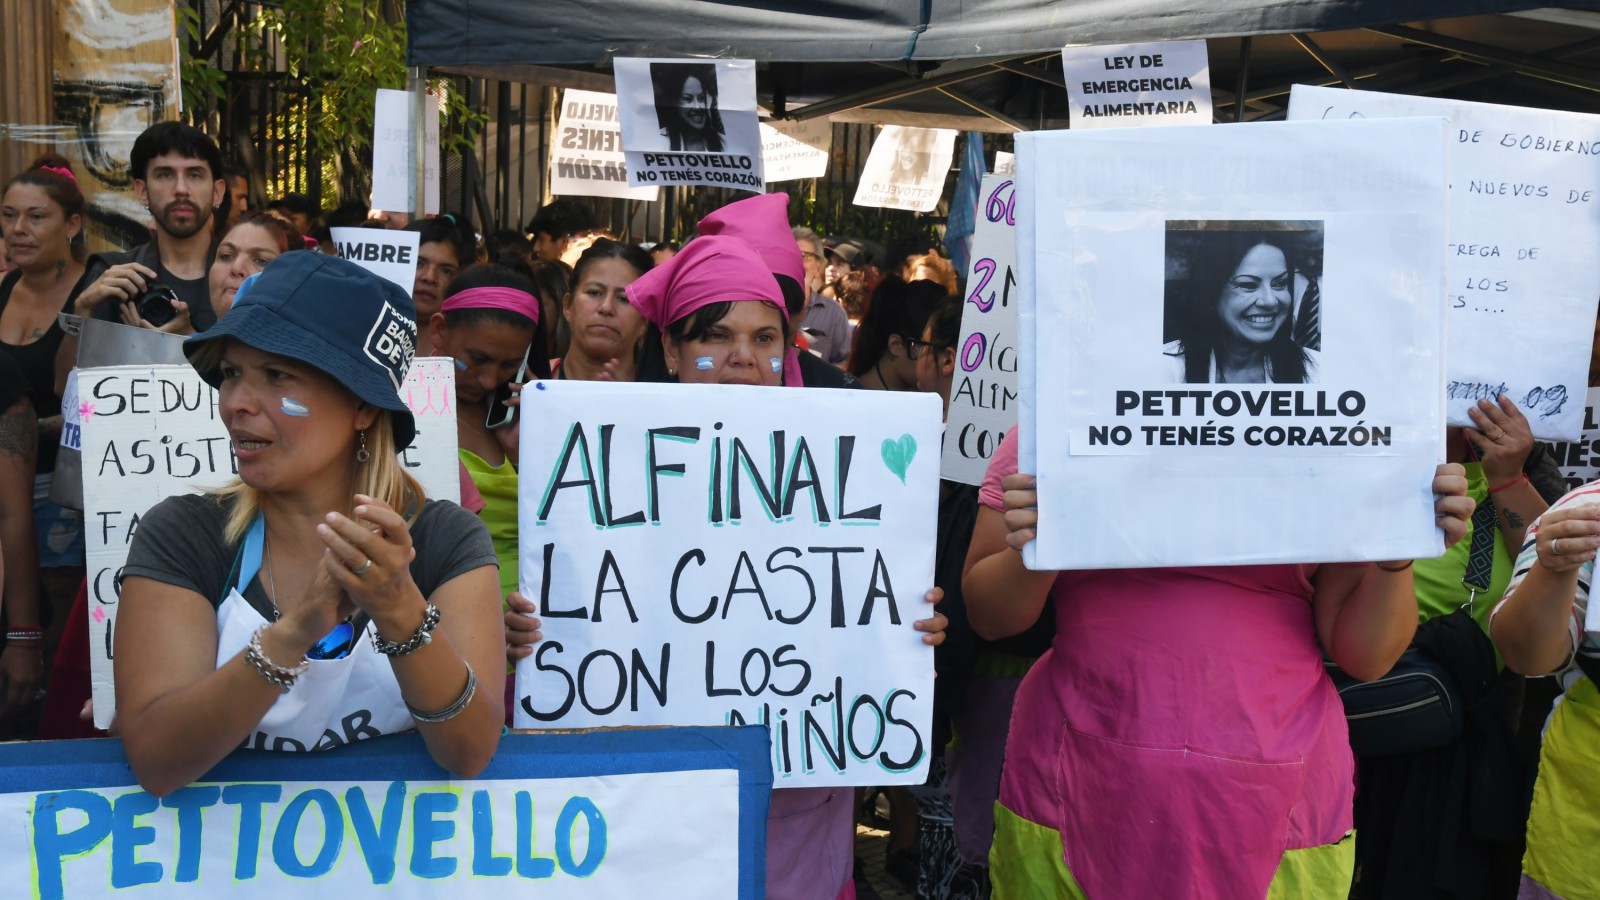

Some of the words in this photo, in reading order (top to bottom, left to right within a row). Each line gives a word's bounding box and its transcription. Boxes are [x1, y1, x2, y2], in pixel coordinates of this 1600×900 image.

[1104, 56, 1135, 70] LEY
[1140, 54, 1163, 68] DE
[1082, 77, 1193, 94] EMERGENCIA
[1083, 100, 1198, 118] ALIMENTARIA
[1458, 129, 1483, 143] DE
[643, 153, 752, 170] PETTOVELLO
[636, 170, 658, 183] NO
[659, 168, 702, 182] TENÉS
[705, 171, 762, 188] CORAZÓN
[1469, 181, 1548, 197] NUEVOS
[1566, 190, 1594, 204] DE
[334, 241, 412, 264] AMBRE
[1518, 248, 1540, 260] DE
[1466, 277, 1509, 292] LOS
[1116, 390, 1366, 417] PETTOVELLO
[1089, 425, 1132, 446] NO
[1141, 420, 1235, 446] TENÉS
[1244, 420, 1392, 446] CORAZÓN
[539, 543, 639, 623] LA
[670, 546, 901, 628] CASTA
[521, 641, 670, 721] SON
[705, 641, 811, 697] LOS
[30, 780, 609, 900] PETTOVELLO
